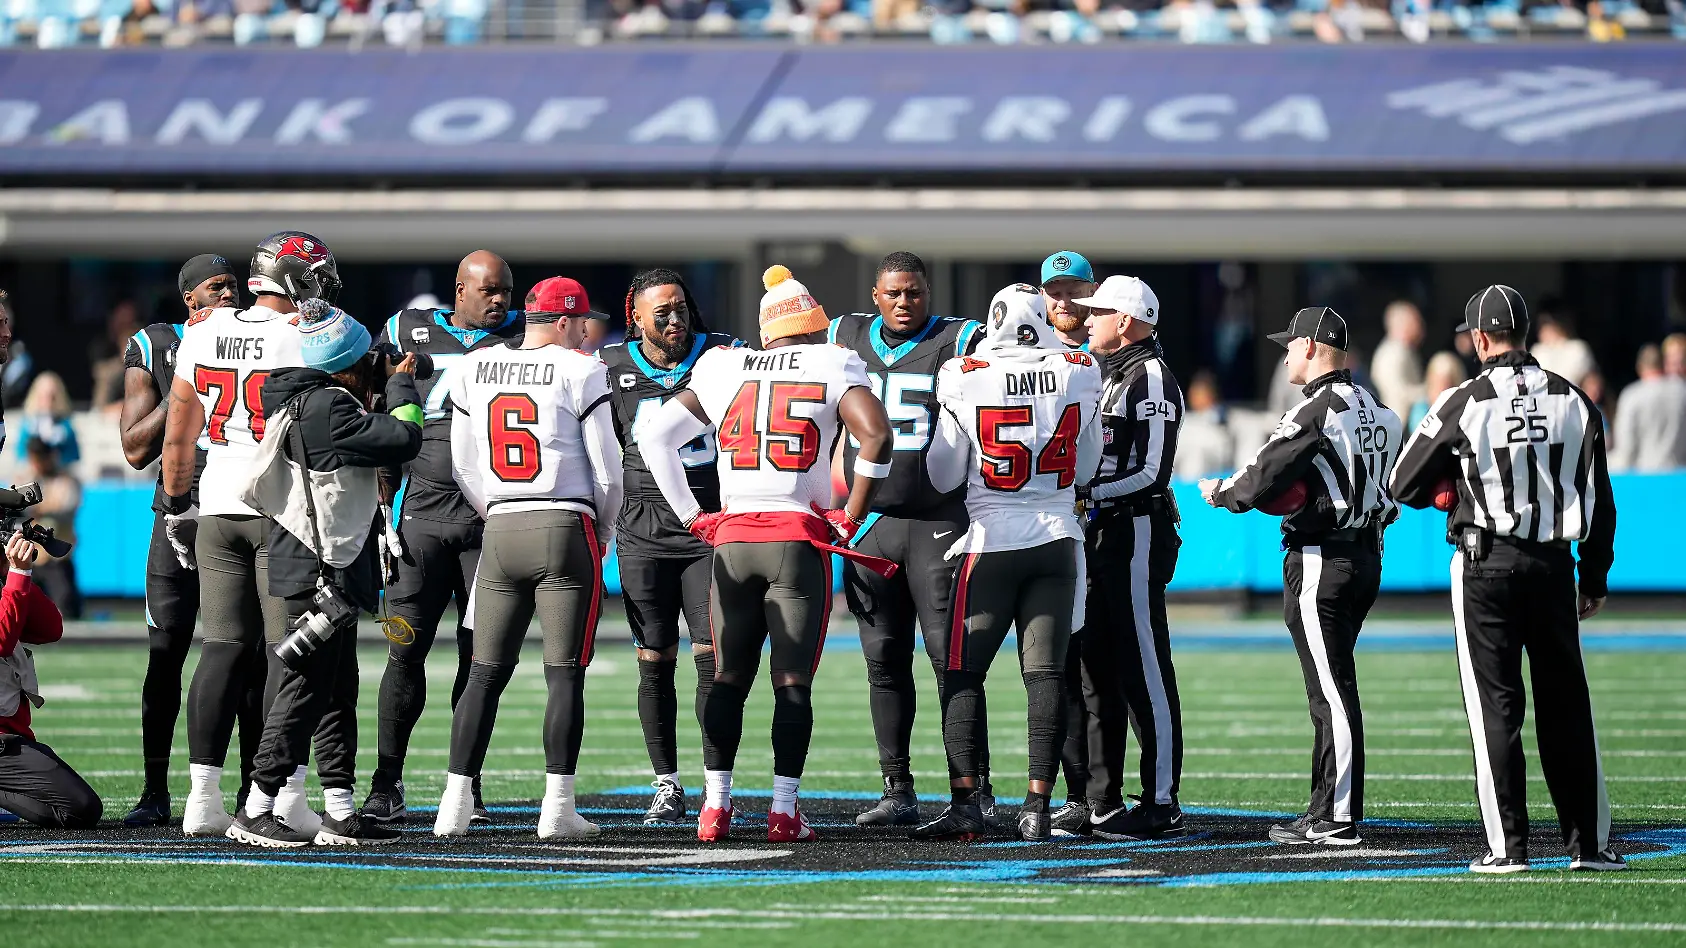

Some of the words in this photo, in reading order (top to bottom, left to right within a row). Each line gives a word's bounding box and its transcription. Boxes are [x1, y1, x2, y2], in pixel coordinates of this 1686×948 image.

[407, 97, 607, 146] OF
[626, 94, 1332, 143] AMERICA
[215, 336, 265, 360] WIRFS
[475, 361, 555, 386] MAYFIELD
[742, 351, 802, 371] WHITE
[1005, 370, 1057, 395] DAVID
[1144, 401, 1170, 418] 34
[1357, 409, 1376, 425] BJ
[1511, 397, 1538, 414] FJ
[488, 392, 542, 483] 6
[718, 379, 828, 473] 45
[1354, 424, 1388, 453] 120
[1505, 415, 1549, 444] 25
[976, 402, 1081, 492] 54
